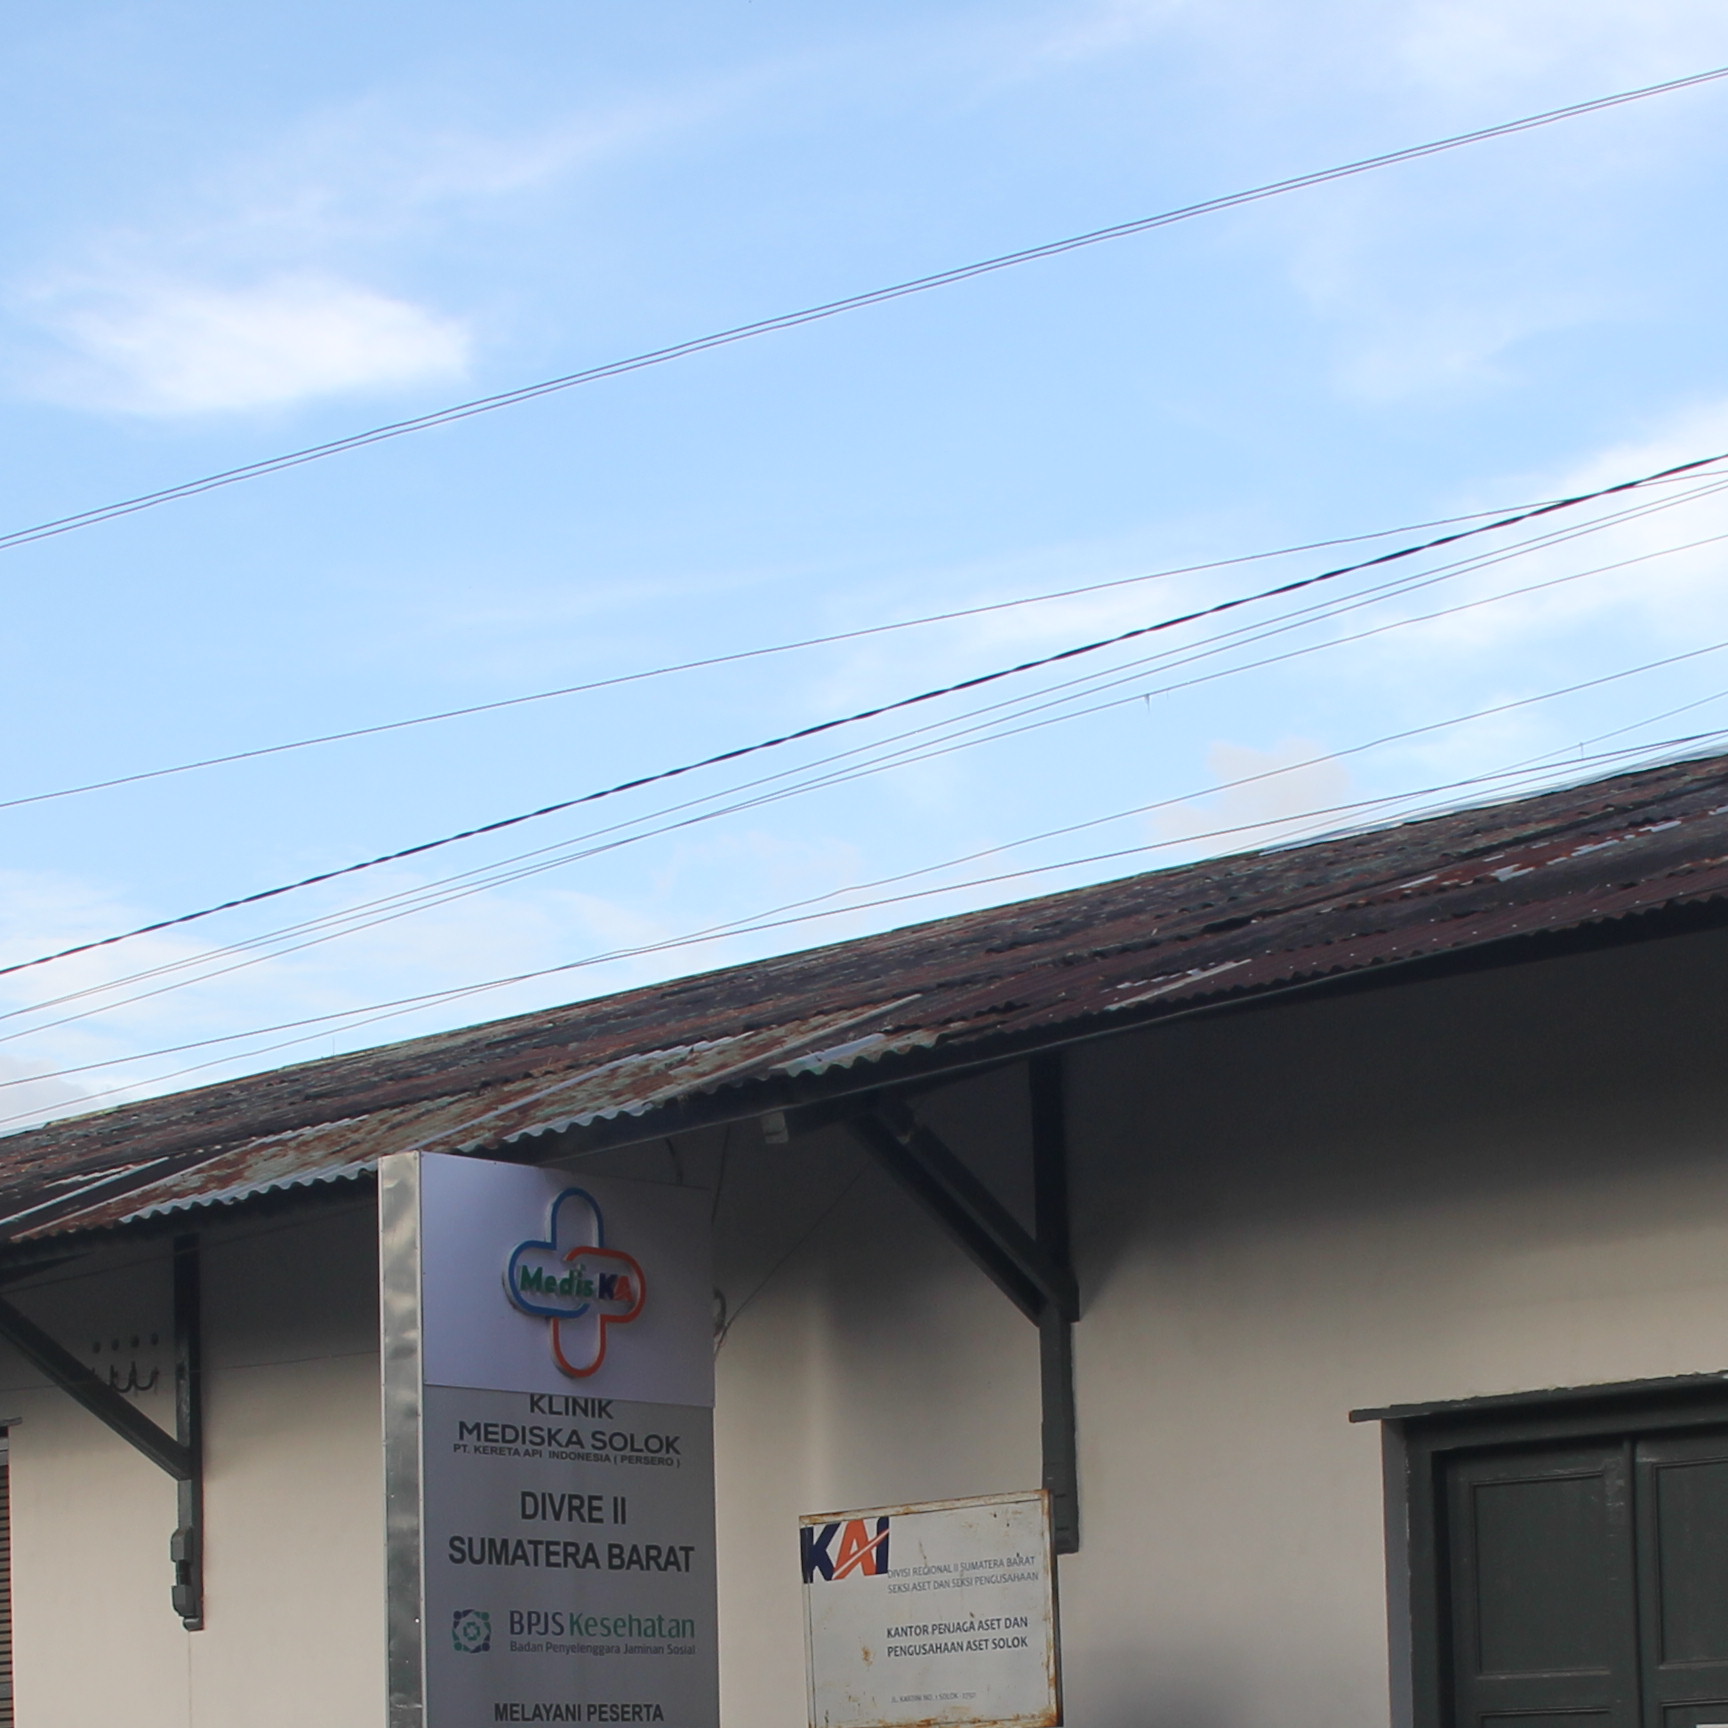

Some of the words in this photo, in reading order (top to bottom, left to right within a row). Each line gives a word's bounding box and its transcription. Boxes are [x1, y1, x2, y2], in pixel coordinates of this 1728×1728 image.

[530, 1393, 614, 1420] KLINIK
[458, 1420, 584, 1449] MEDISKA
[591, 1431, 681, 1455] SOLOK
[453, 1444, 469, 1453] PT.
[474, 1445, 521, 1457] KERETA
[523, 1449, 543, 1459] API
[549, 1450, 612, 1464] INDONESIA
[620, 1455, 674, 1467] PERSERO
[521, 1490, 604, 1524] DIVRE
[613, 1496, 626, 1525] II
[449, 1535, 601, 1570] SUMATERA
[607, 1543, 695, 1573] BARAT
[799, 1516, 890, 1584] KAI
[887, 1567, 911, 1579] DIVISI
[912, 1564, 953, 1577] REGIONAL
[960, 1559, 1005, 1573] SUMATERA
[1006, 1555, 1035, 1568] BARAT
[887, 1582, 910, 1594] SEKSI
[911, 1581, 932, 1593] ASET
[933, 1579, 951, 1591] DAN
[952, 1577, 973, 1589] SEKSI
[974, 1572, 1039, 1586] PENGUSAHAAN
[510, 1610, 565, 1636] BPJS
[569, 1612, 695, 1639] Kesehatan
[887, 1624, 930, 1639] KANTOR
[931, 1620, 976, 1636] PENJAGA
[977, 1618, 1003, 1632] ASET
[1004, 1616, 1028, 1630] DAN
[510, 1640, 543, 1654] Badan
[546, 1641, 621, 1656] Penyelenggara
[623, 1643, 665, 1655] Jaminan
[667, 1643, 696, 1656] Sosial
[887, 1640, 964, 1658] PENGUSAHAAN
[965, 1638, 990, 1652] ASET
[991, 1636, 1028, 1651] SOLOK
[494, 1703, 582, 1722] MELAYANI
[587, 1703, 664, 1722] PESERTA
